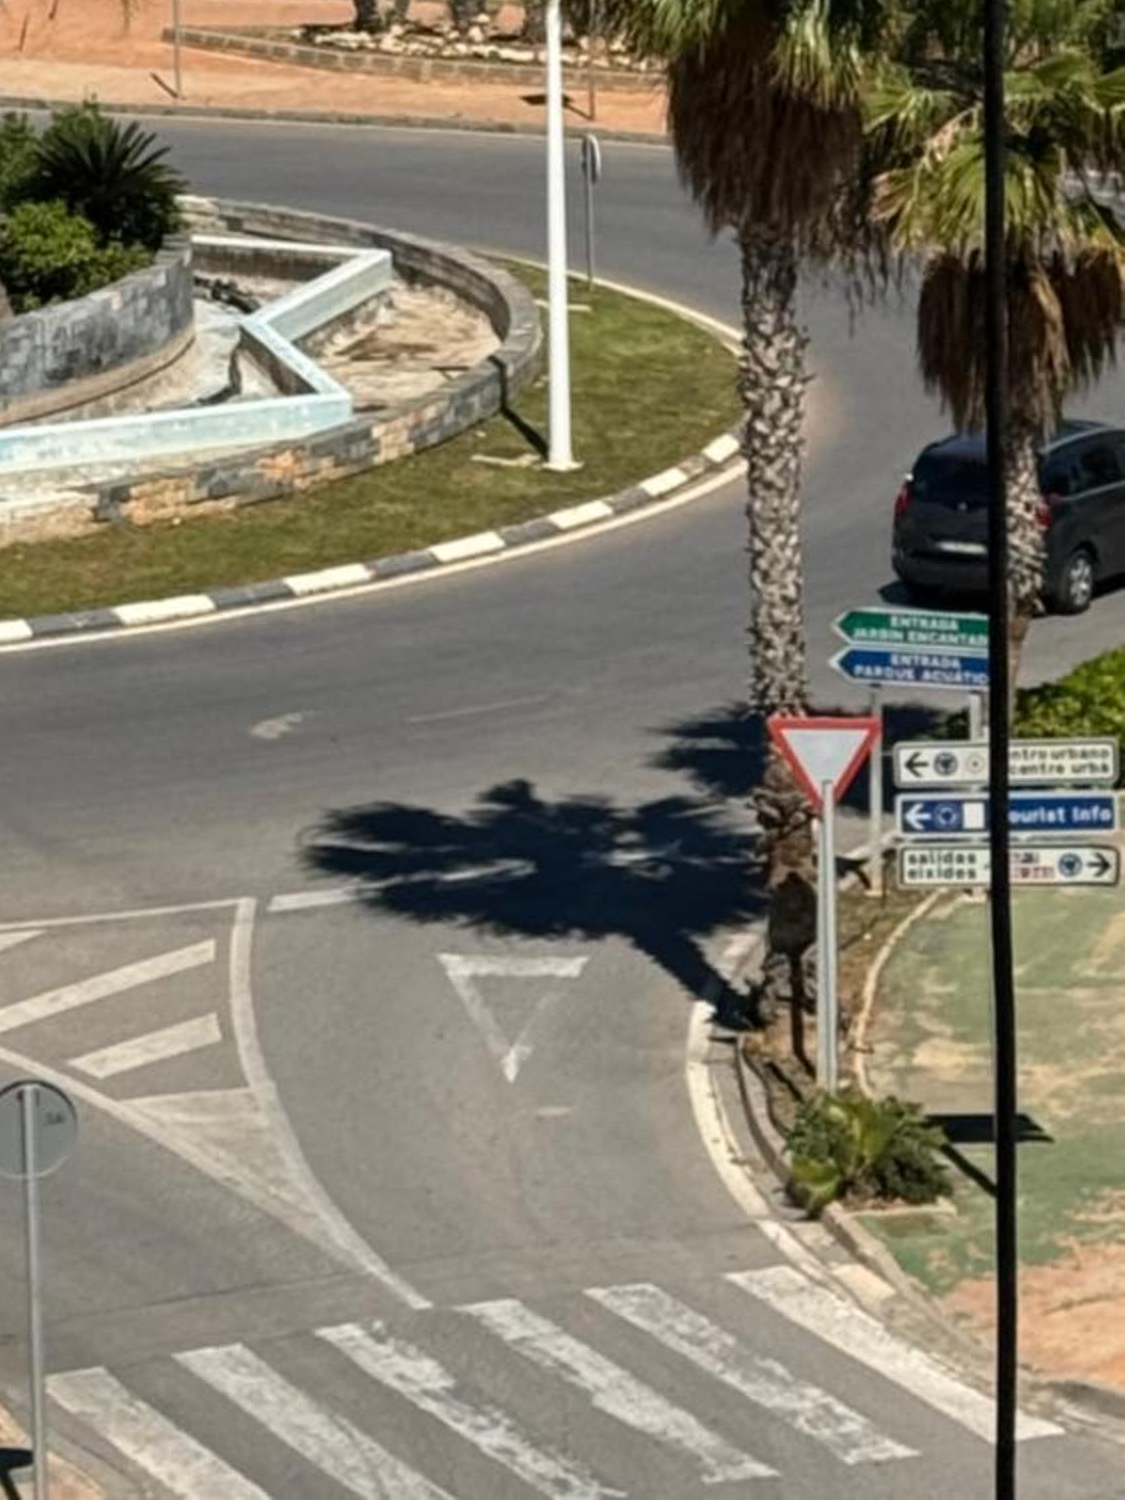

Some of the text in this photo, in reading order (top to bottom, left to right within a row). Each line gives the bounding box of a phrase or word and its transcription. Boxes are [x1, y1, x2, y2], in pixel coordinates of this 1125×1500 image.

[890, 615, 959, 631] ENTRADA
[907, 630, 989, 646] ENCANTAD
[890, 653, 962, 669] ENTRADA
[854, 665, 915, 680] PARQUE
[1008, 805, 1067, 824] ourist
[907, 850, 977, 865] salidas
[907, 866, 977, 880] eixides
